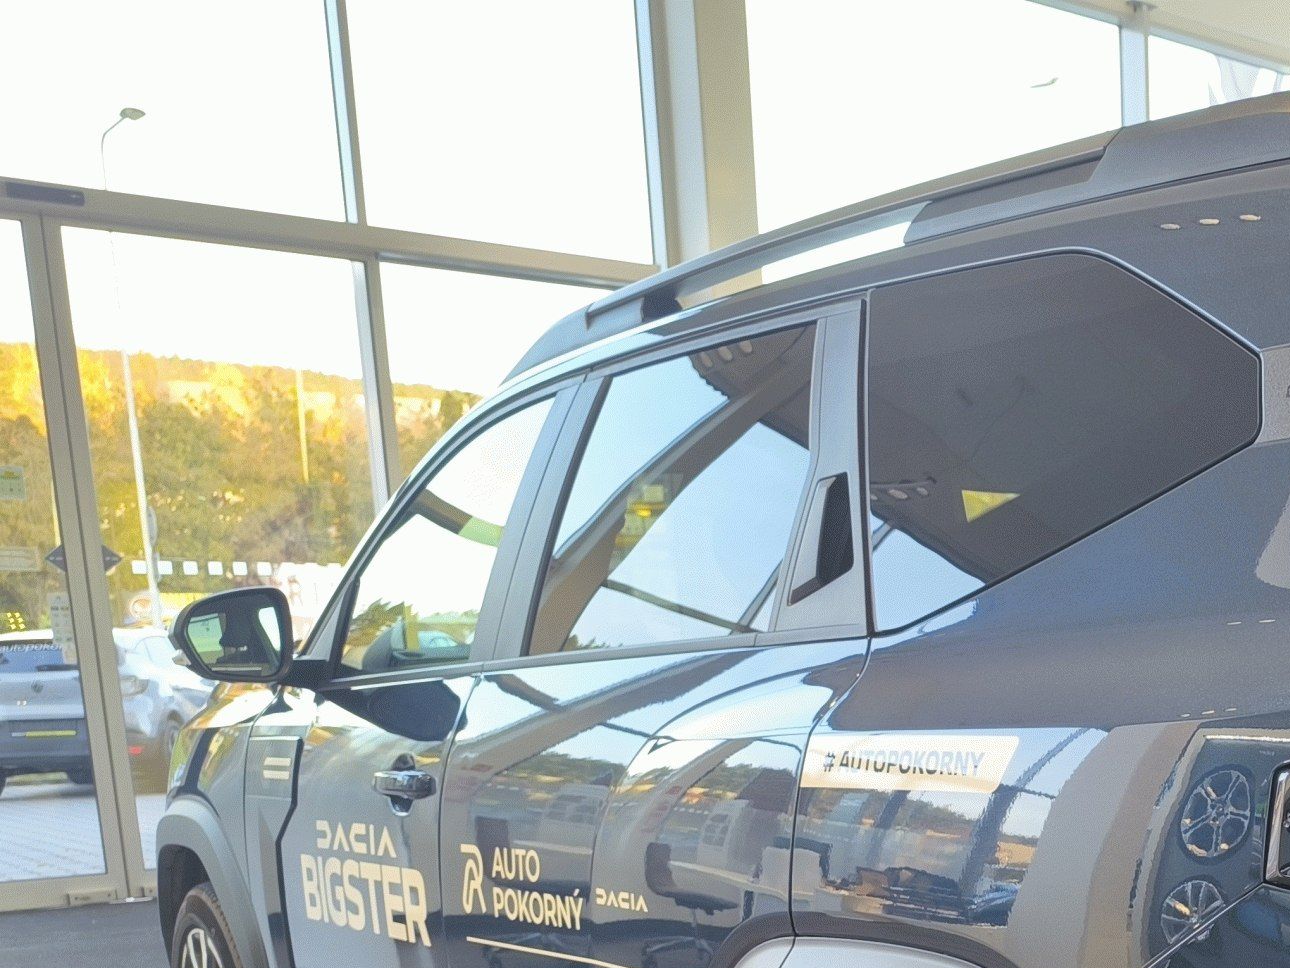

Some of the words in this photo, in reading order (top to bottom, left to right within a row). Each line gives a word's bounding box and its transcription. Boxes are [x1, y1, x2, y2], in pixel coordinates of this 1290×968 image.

[316, 820, 397, 858] DACIA
[491, 847, 541, 883] AUTO
[301, 854, 432, 947] BIGSTER
[493, 887, 583, 931] POKORNÝ
[596, 887, 648, 913] DACIA
